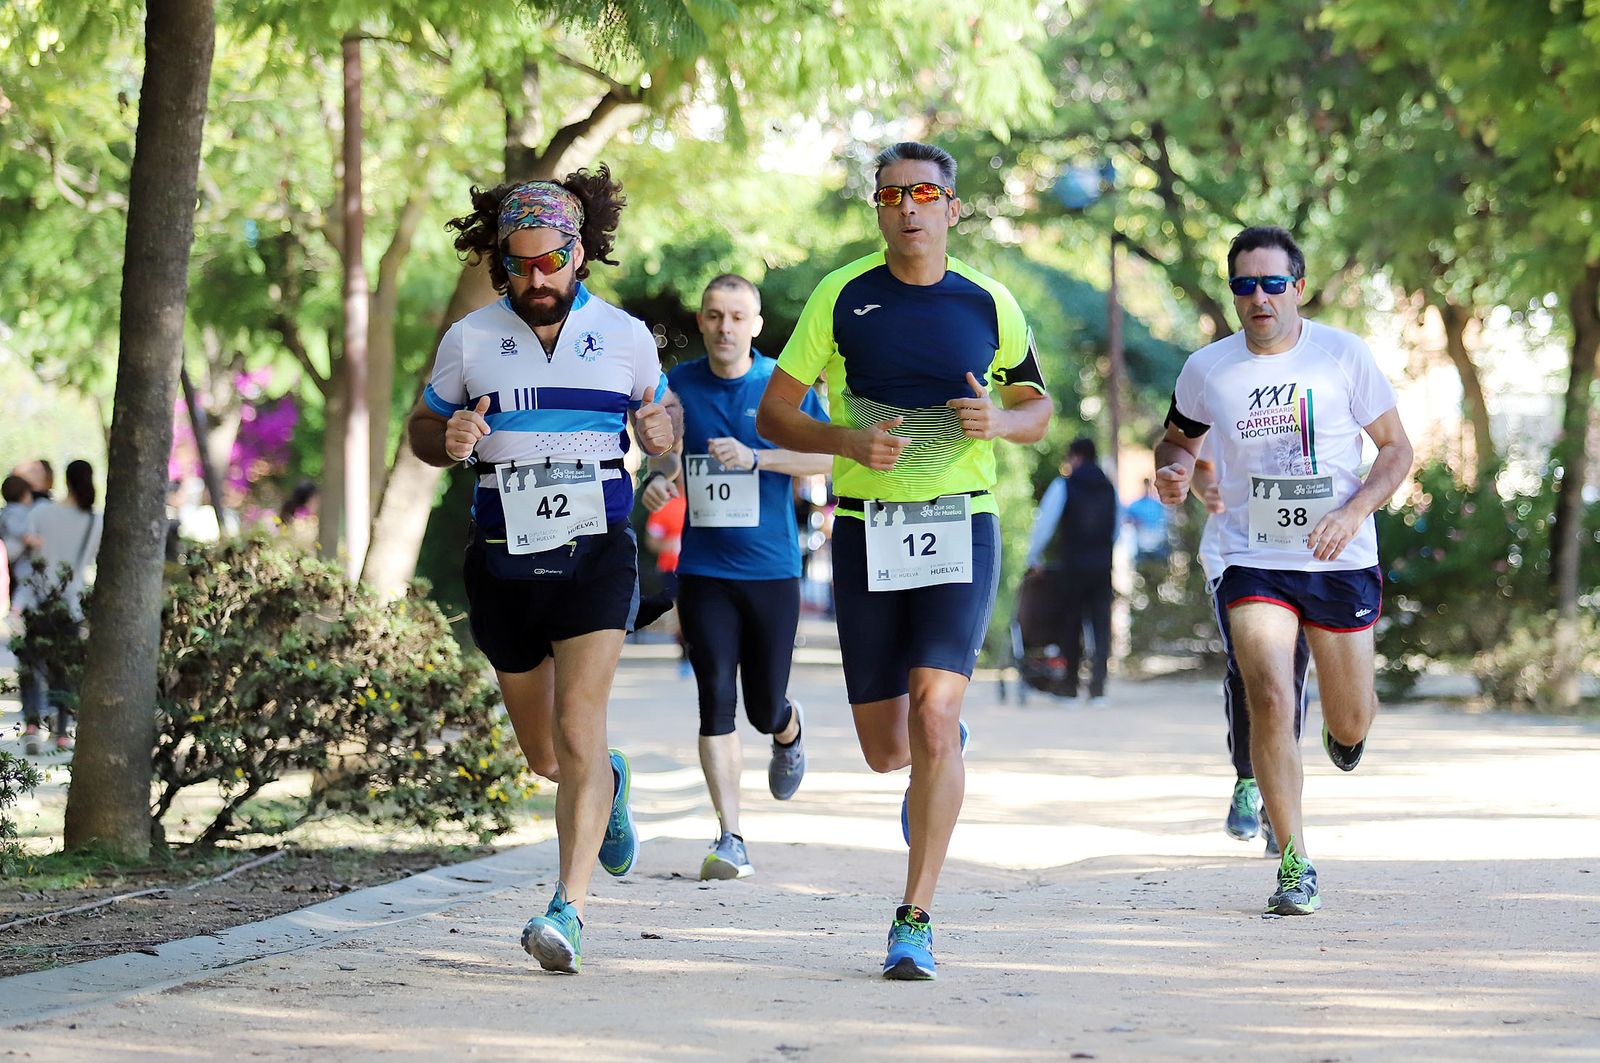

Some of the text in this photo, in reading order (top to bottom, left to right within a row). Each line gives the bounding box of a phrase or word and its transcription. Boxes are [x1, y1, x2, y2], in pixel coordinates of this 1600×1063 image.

[1248, 382, 1297, 411] XXI
[1249, 407, 1296, 417] ANIVERSARIO
[1236, 414, 1297, 431] CARRERA
[1241, 424, 1302, 439] NOCTURNA
[705, 483, 731, 501] 10
[536, 493, 571, 520] 42
[933, 503, 945, 511] Que
[1277, 507, 1308, 528] 38
[568, 521, 594, 535] HUELVA
[902, 532, 937, 557] 12
[930, 566, 959, 576] HUELVA
